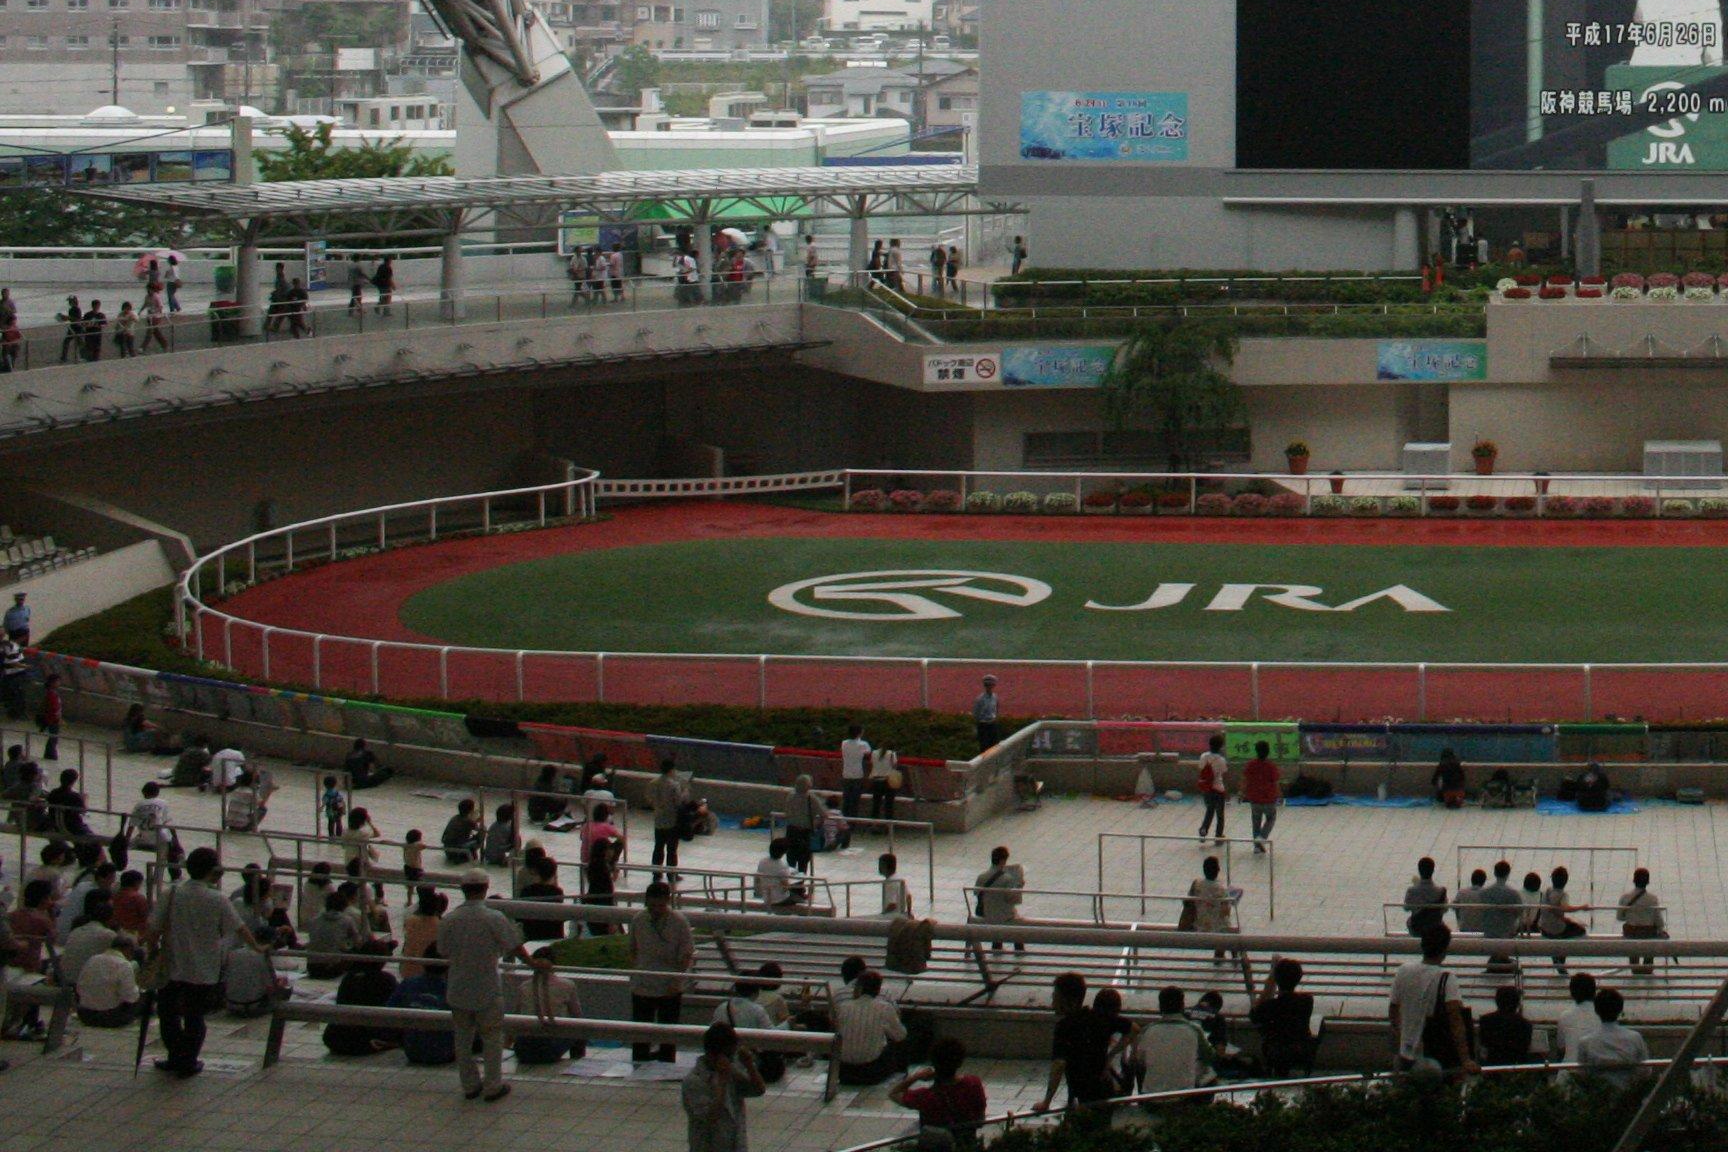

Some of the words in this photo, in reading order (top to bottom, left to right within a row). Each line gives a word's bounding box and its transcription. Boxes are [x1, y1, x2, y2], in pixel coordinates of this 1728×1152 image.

[1067, 112, 1185, 139] 宝塚記念
[1642, 142, 1696, 165] JRA
[1084, 582, 1453, 613] JRA
